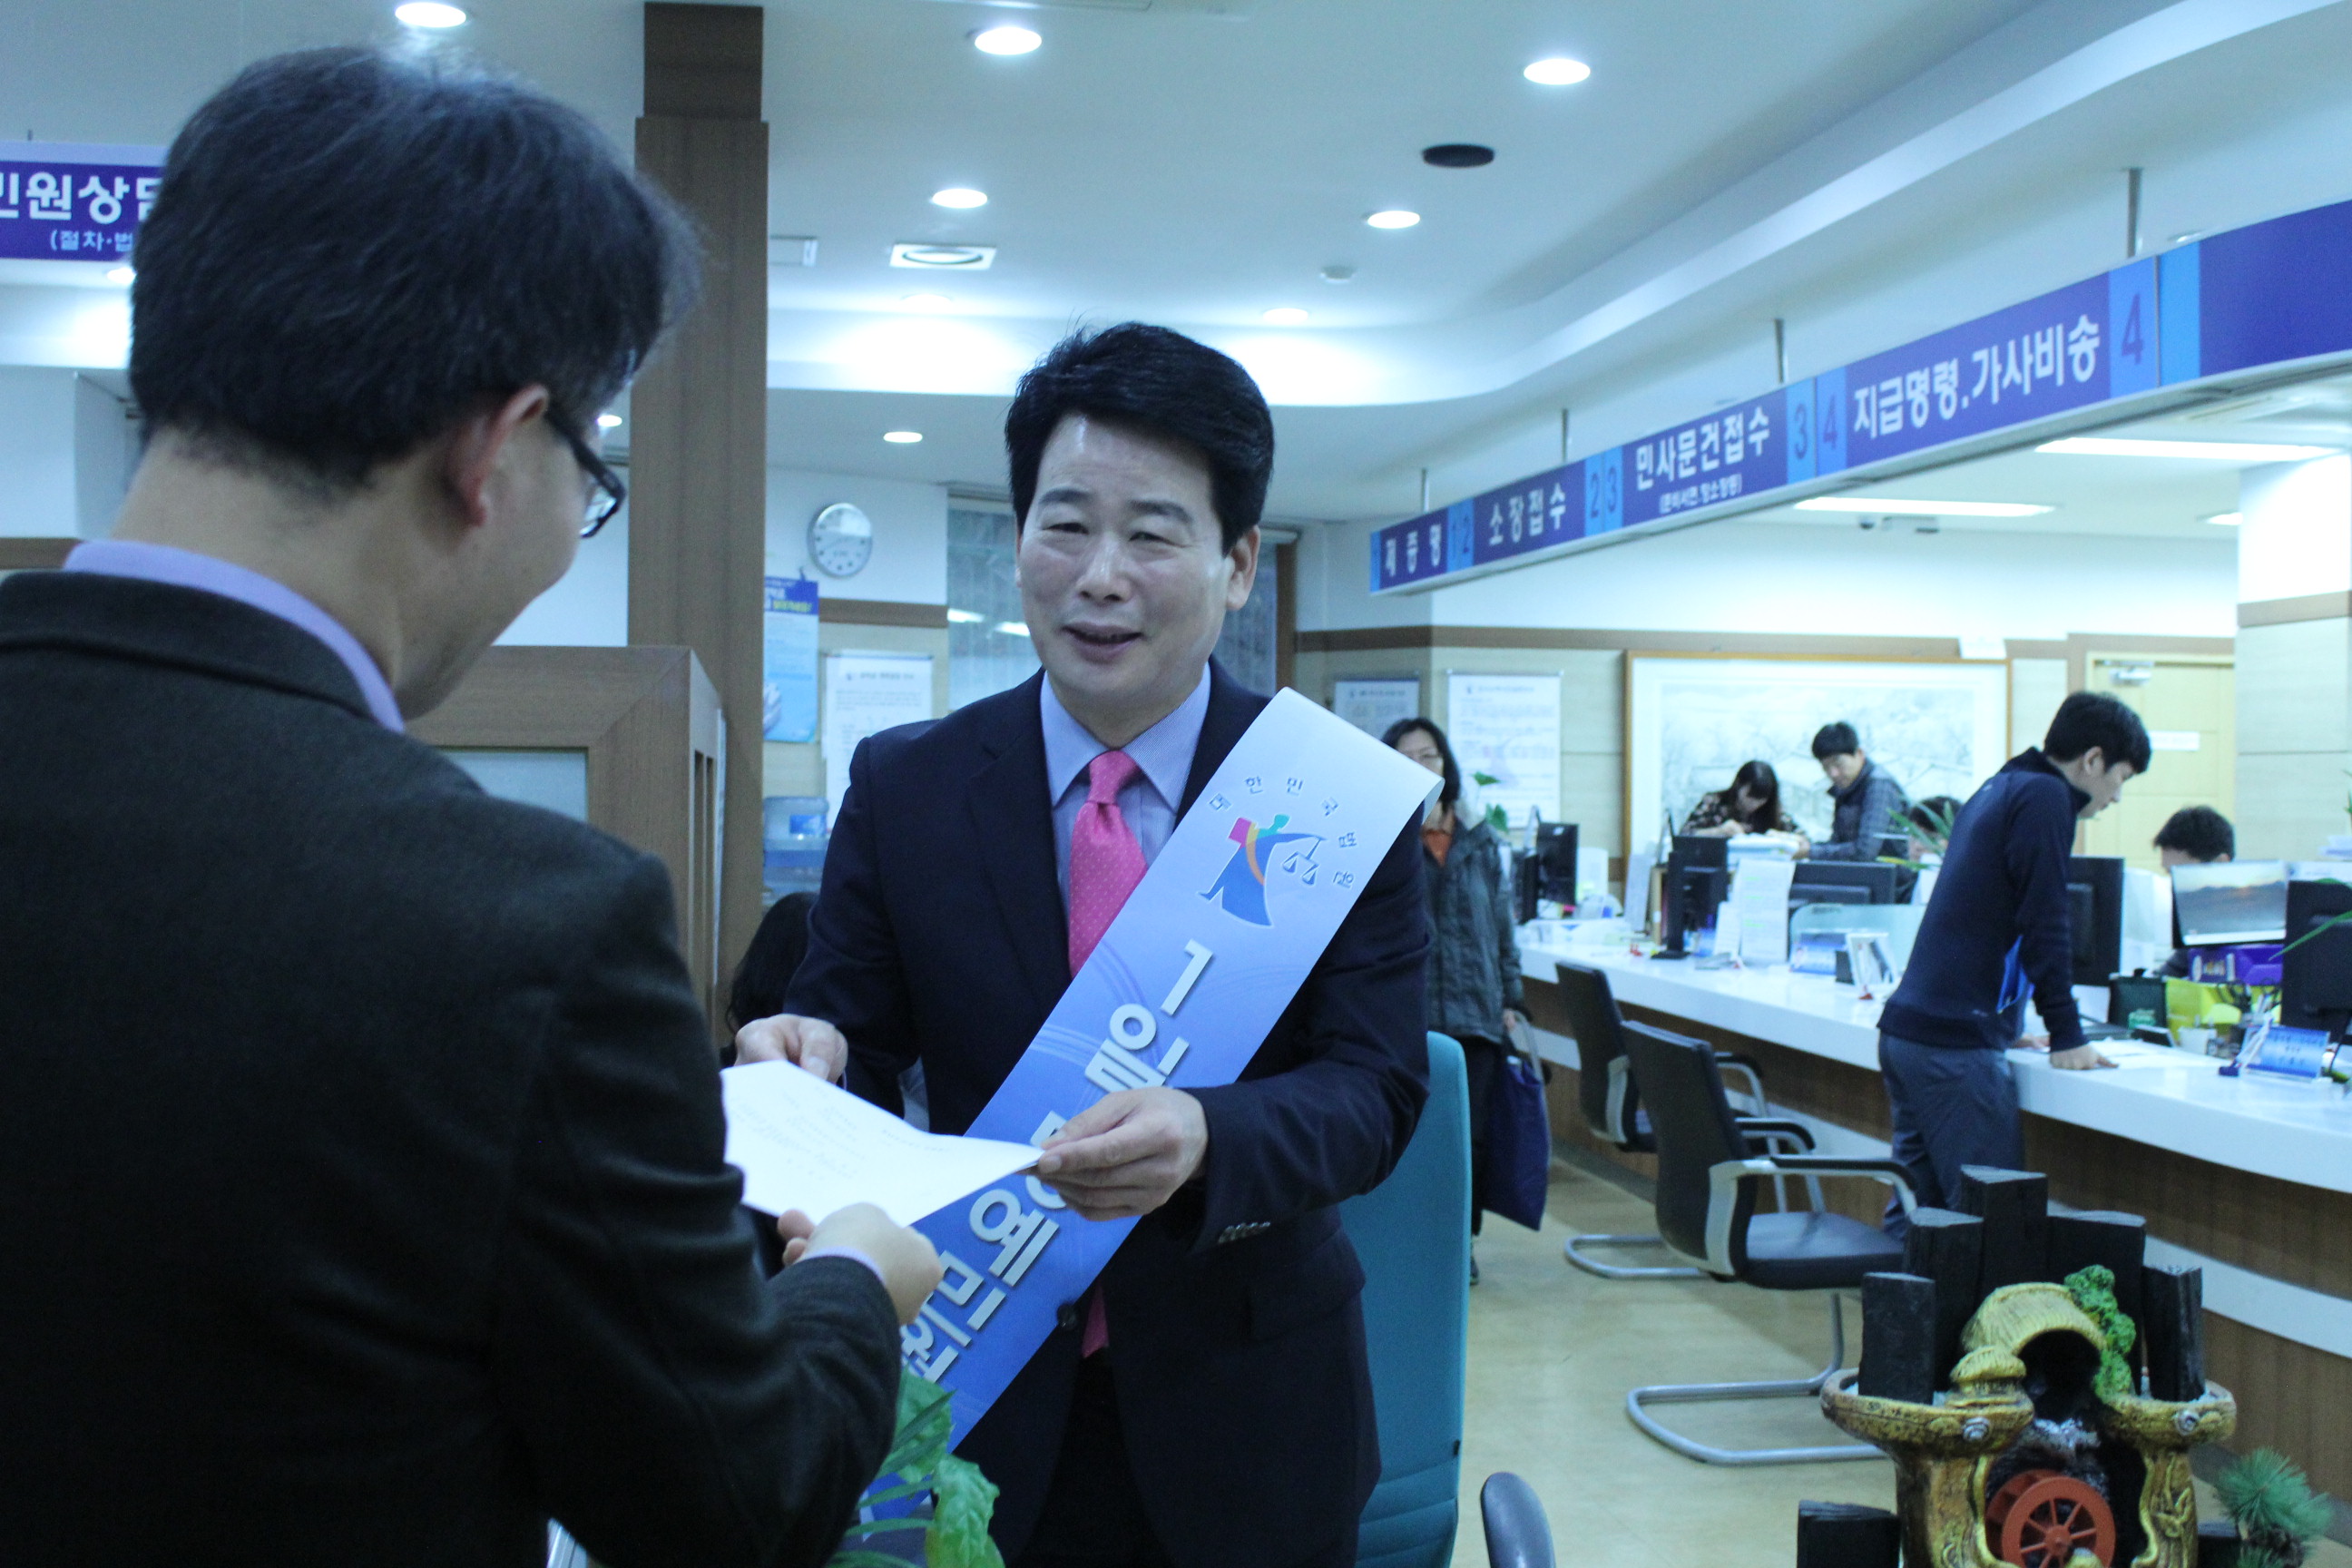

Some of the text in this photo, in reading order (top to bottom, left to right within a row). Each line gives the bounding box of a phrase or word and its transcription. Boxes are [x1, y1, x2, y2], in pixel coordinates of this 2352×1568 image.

[1823, 392, 1838, 450] 4
[2121, 293, 2144, 365] 4
[1488, 481, 1567, 546] 소장접수
[1589, 472, 1602, 518] 2
[1606, 402, 1808, 514] 3 민사문건접수 3
